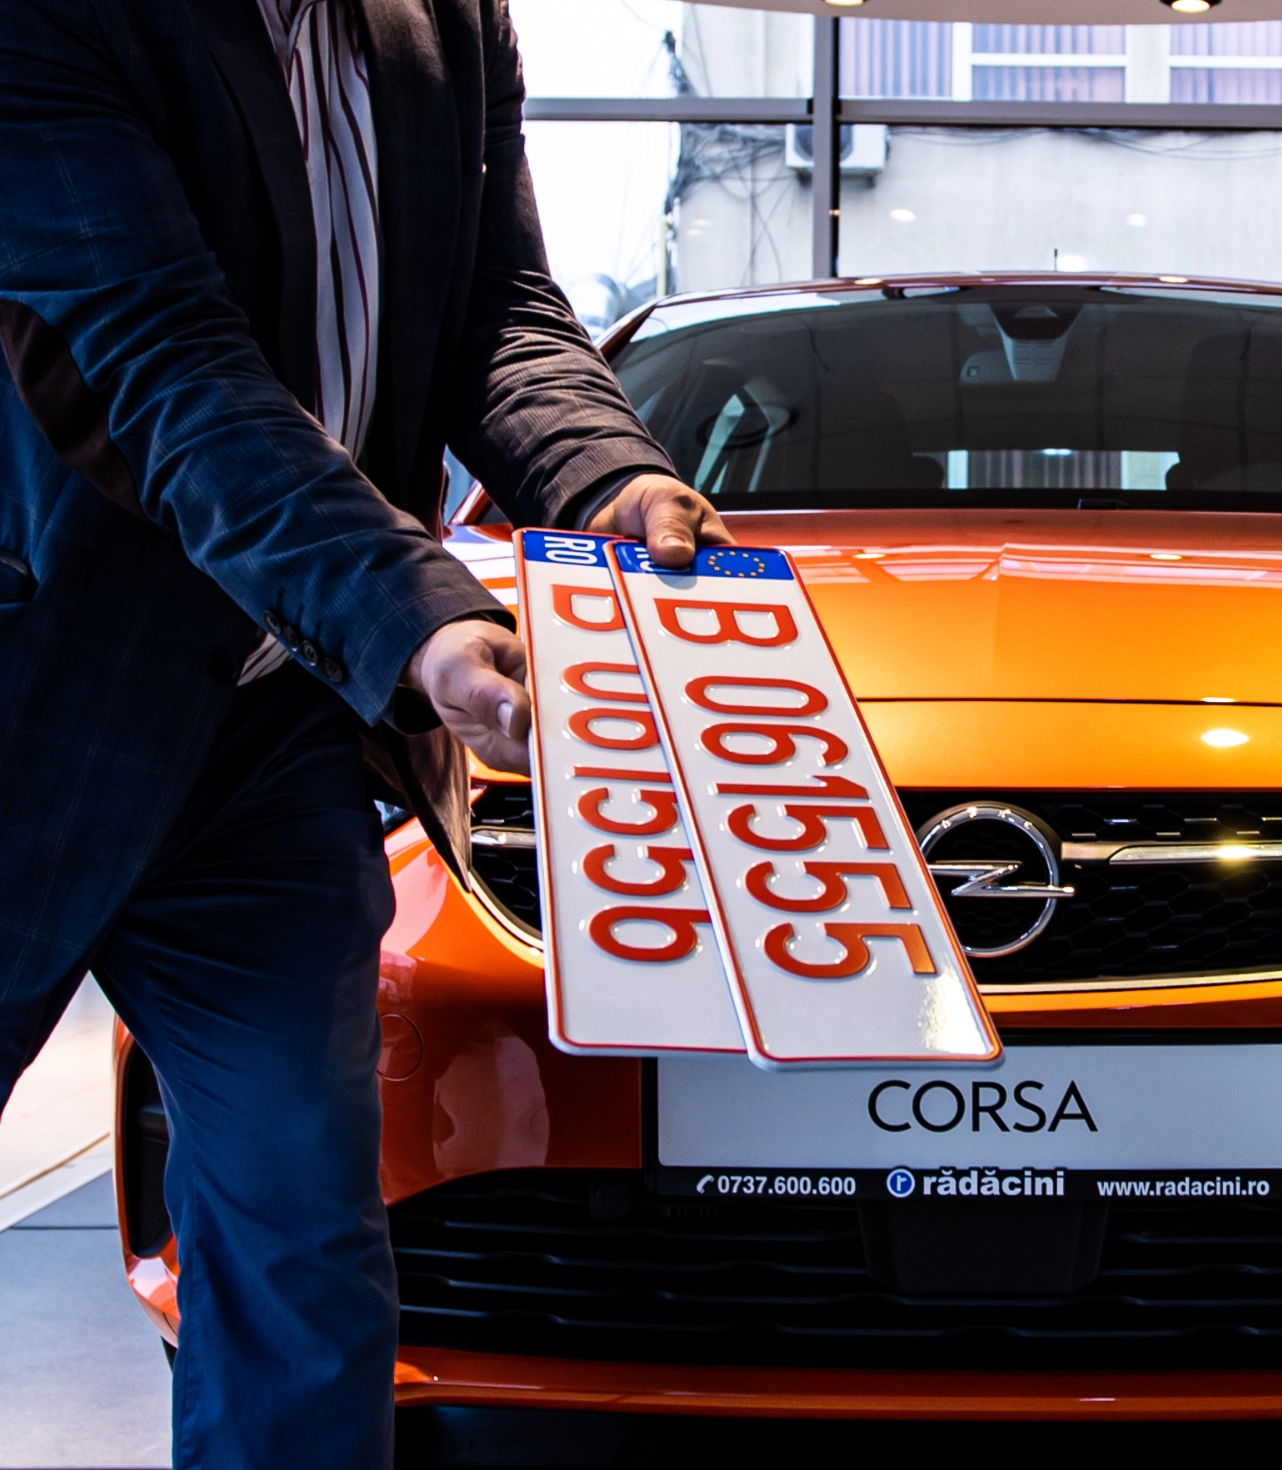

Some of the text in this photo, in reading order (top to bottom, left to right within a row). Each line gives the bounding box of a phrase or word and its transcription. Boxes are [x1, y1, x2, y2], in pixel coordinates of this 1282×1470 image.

[543, 535, 598, 565] RO
[653, 597, 938, 979] B 061555
[867, 1079, 1098, 1133] CORSA
[717, 1175, 856, 1195] 0737.600.600
[923, 1170, 1065, 1196] rădăcini
[1097, 1176, 1270, 1196] www.radacini.ro
